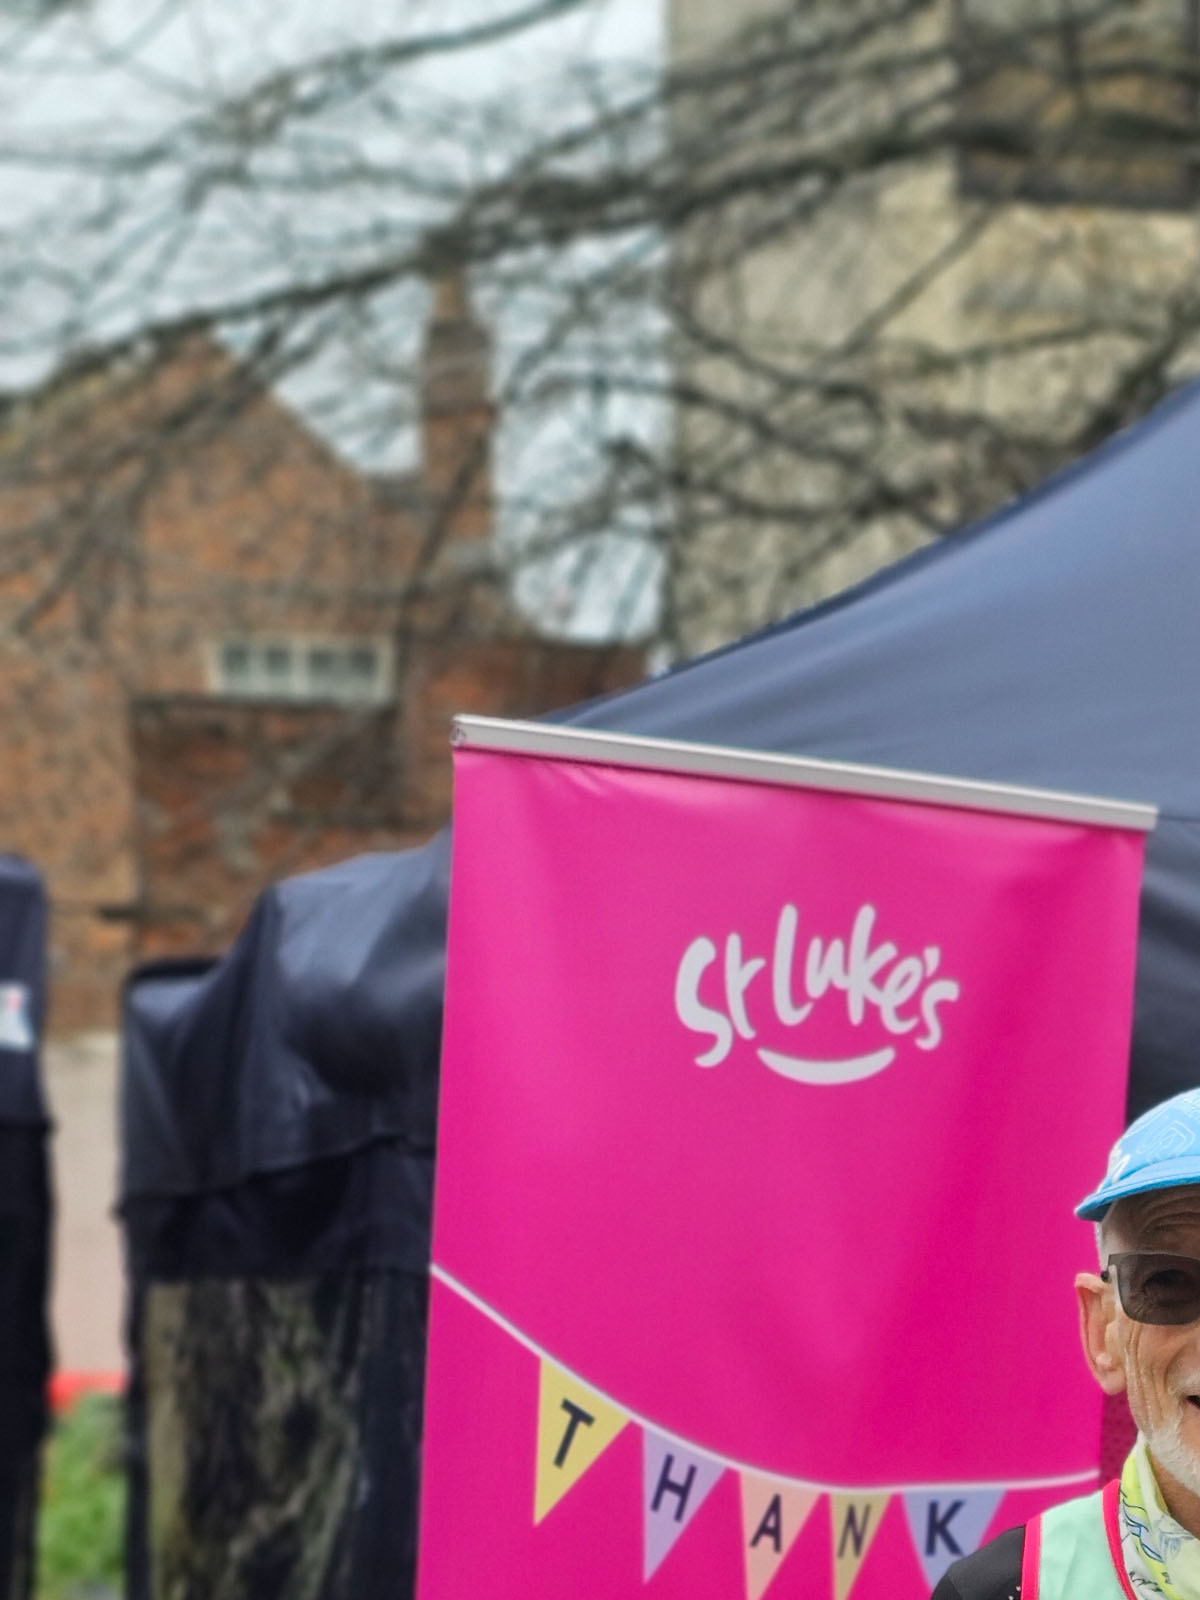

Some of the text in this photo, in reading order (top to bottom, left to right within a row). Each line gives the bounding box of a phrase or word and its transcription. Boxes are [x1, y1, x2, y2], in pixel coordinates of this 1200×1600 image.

[674, 903, 961, 1068] St Luke's
[553, 1397, 967, 1558] THANK
